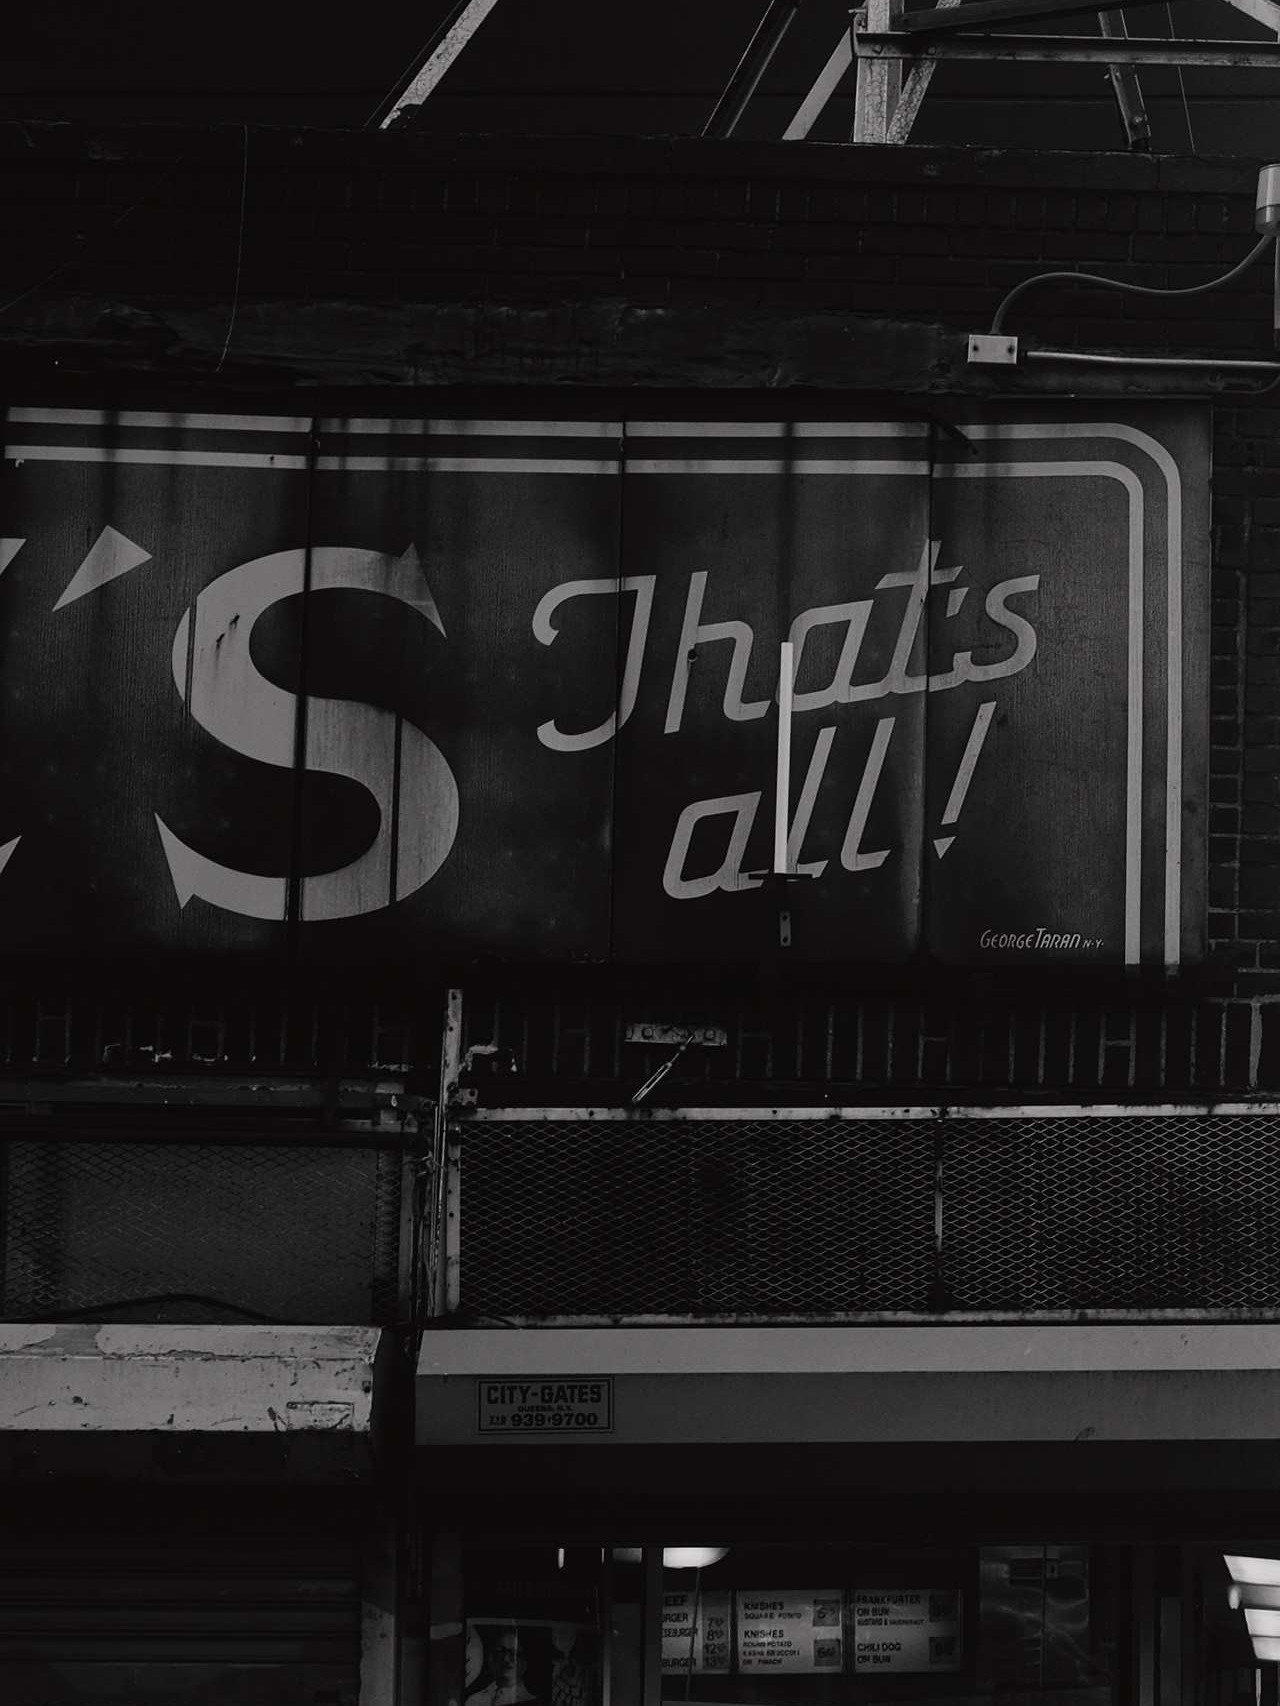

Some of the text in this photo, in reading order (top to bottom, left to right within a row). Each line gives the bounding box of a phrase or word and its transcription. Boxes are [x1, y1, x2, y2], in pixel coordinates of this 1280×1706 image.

[533, 538, 1040, 753] That's
[0, 522, 460, 922] 'S
[662, 700, 996, 901] all!
[979, 929, 1034, 949] GEORGE
[1034, 927, 1081, 949] TARAN
[486, 1384, 602, 1405] CITY-GATES
[857, 1594, 921, 1605] FRANKFURTER
[744, 1601, 784, 1611] KNISHES
[744, 1612, 775, 1620] SQUARE
[857, 1607, 890, 1617] ON BUN
[744, 1629, 784, 1639] KNISHES
[857, 1642, 902, 1652] CHILI DOG
[857, 1654, 891, 1664] ON BUN
